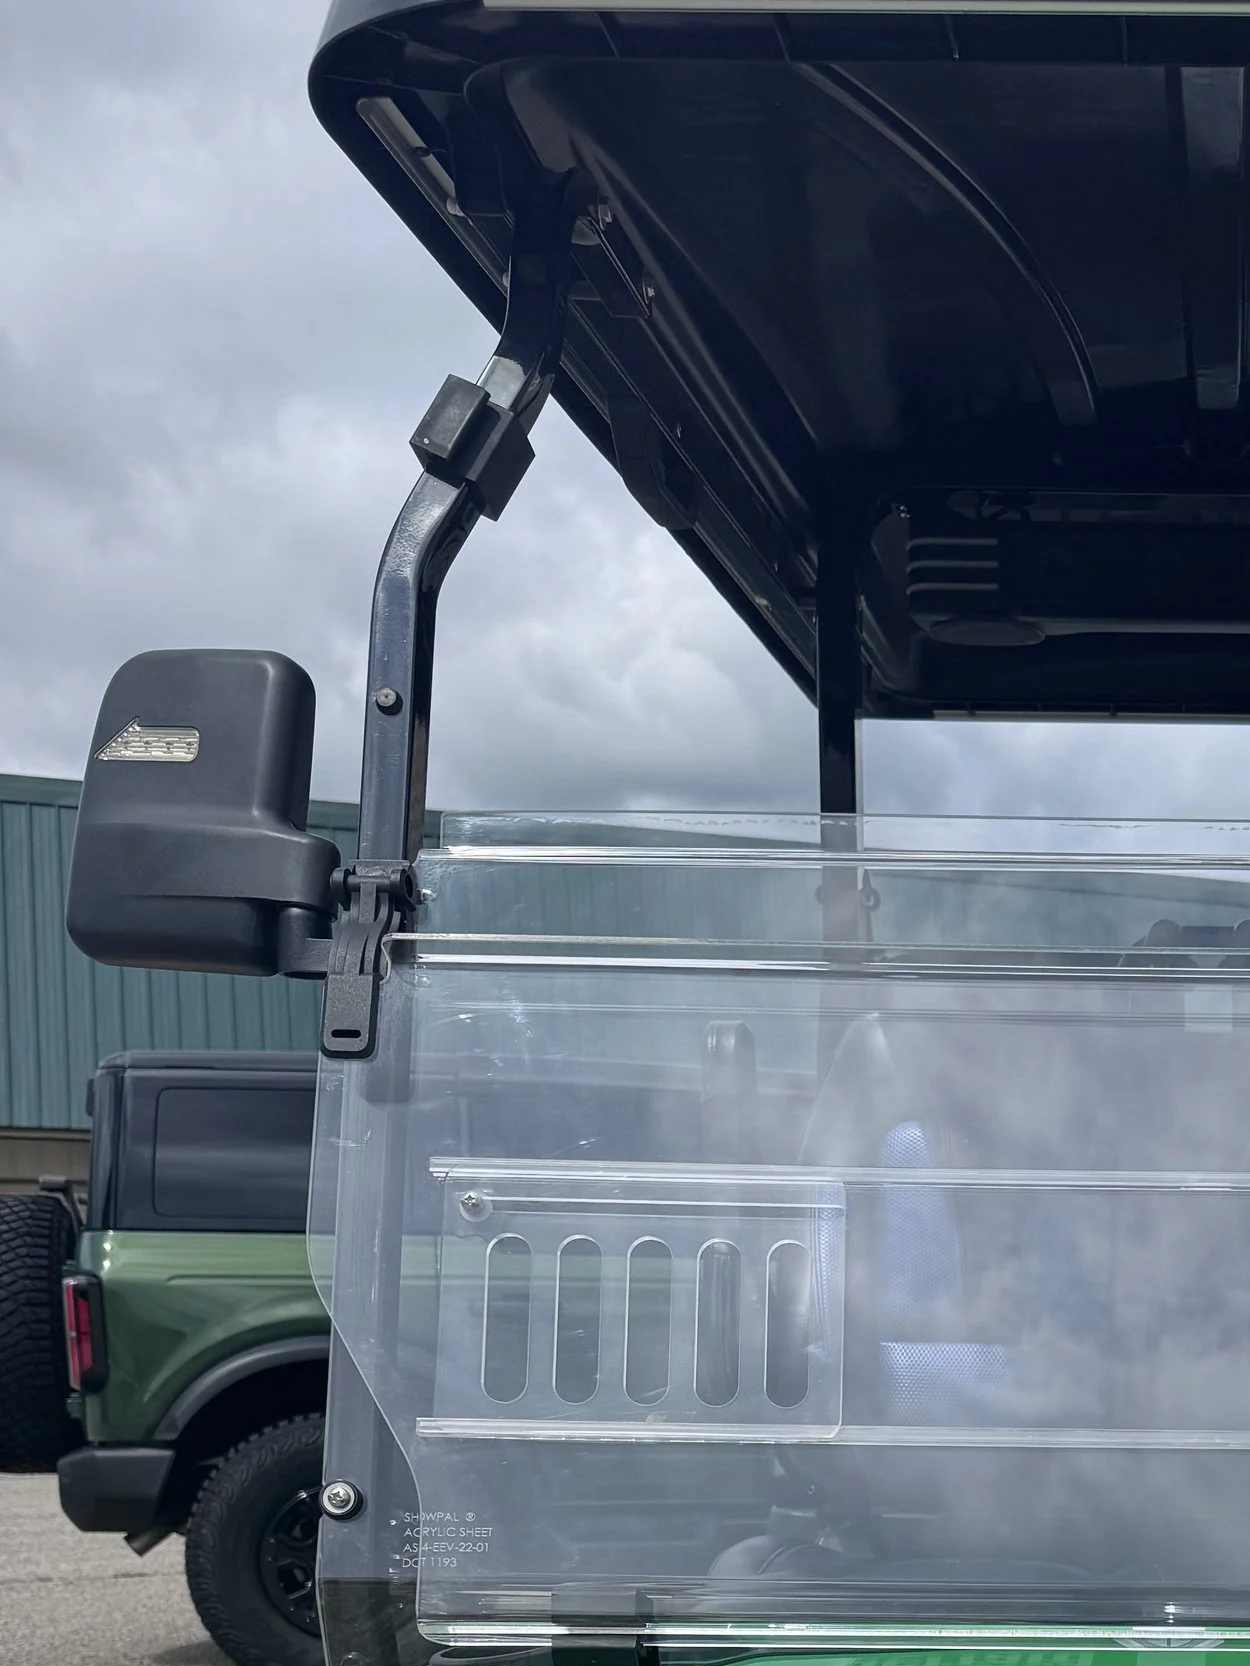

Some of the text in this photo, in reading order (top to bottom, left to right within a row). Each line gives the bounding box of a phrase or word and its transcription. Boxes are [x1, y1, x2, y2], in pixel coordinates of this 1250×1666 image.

[403, 1527, 493, 1537] ACRYLIC SHEET
[430, 1557, 457, 1567] 1193
